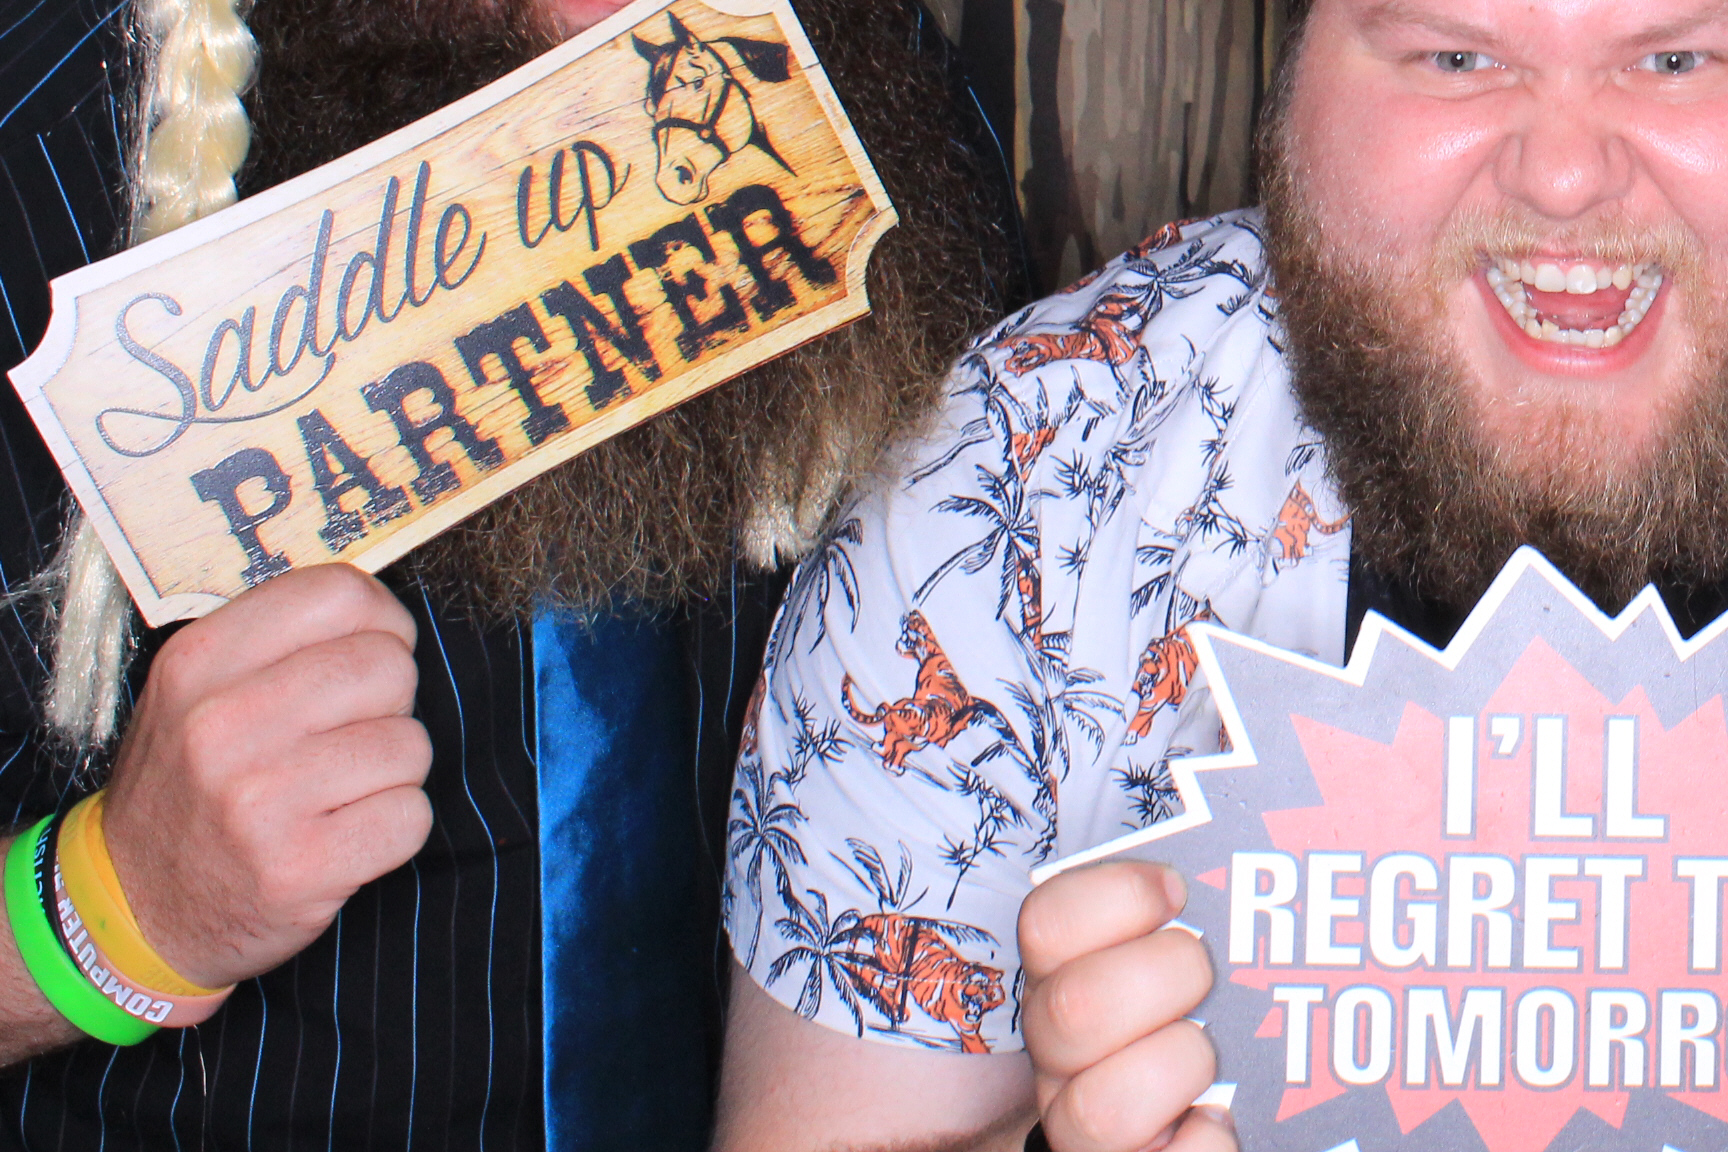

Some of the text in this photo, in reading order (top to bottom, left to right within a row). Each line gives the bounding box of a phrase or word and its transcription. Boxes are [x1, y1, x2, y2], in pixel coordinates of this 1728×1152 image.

[95, 139, 631, 457] Saddle up
[189, 182, 837, 589] PARTNER
[1445, 715, 1666, 839] I'LL
[56, 897, 174, 1023] COMPUTER
[1228, 853, 1633, 970] REGRET
